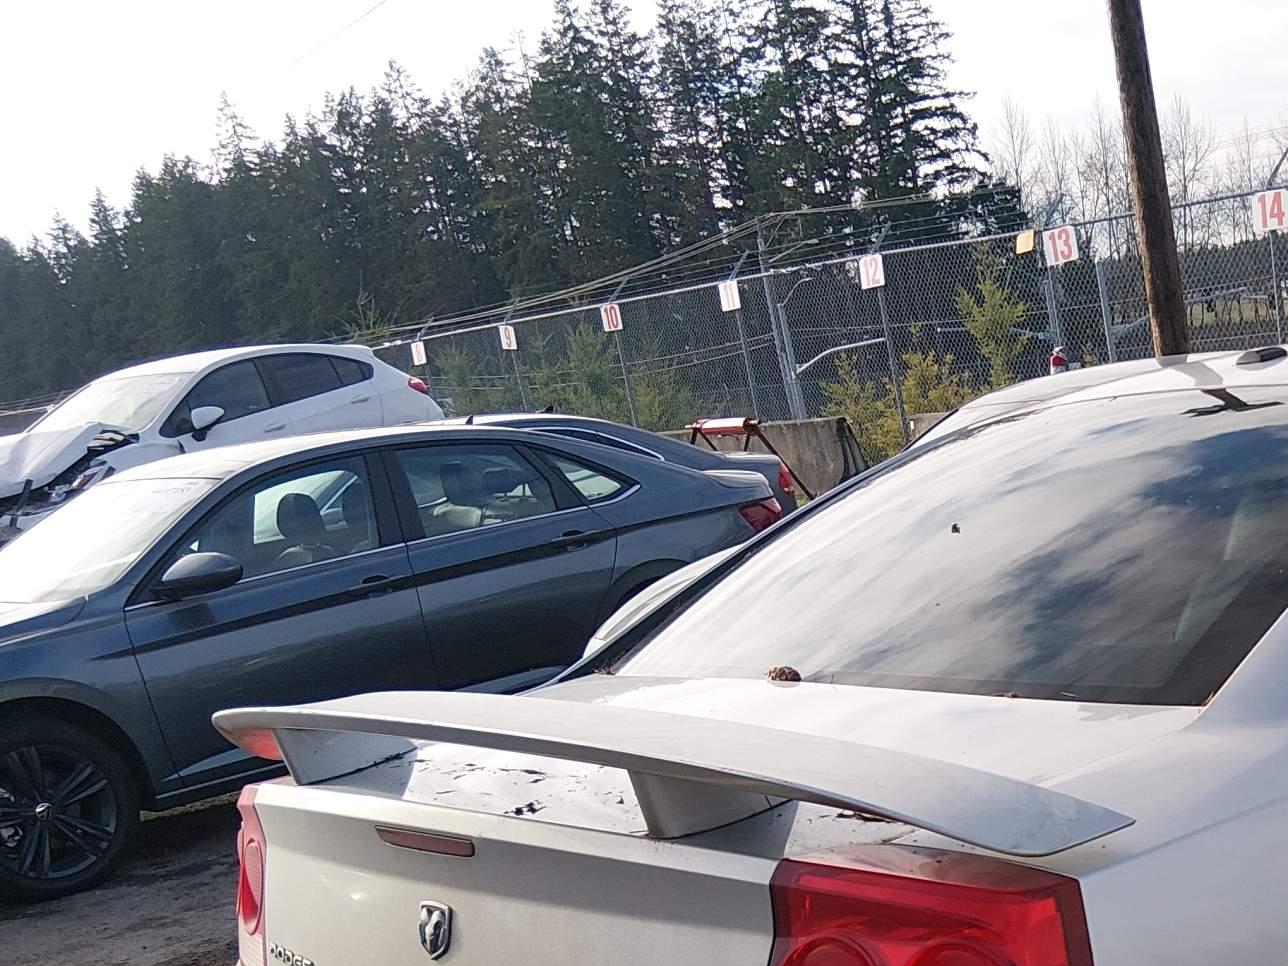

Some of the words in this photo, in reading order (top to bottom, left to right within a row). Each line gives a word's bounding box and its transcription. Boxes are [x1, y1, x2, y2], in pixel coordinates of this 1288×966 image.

[1257, 190, 1286, 229] 14
[1048, 228, 1073, 263] 13
[862, 258, 881, 286] 12
[724, 284, 736, 309] 11
[603, 305, 619, 330] 10
[503, 326, 513, 348] 9
[415, 342, 424, 363] 8
